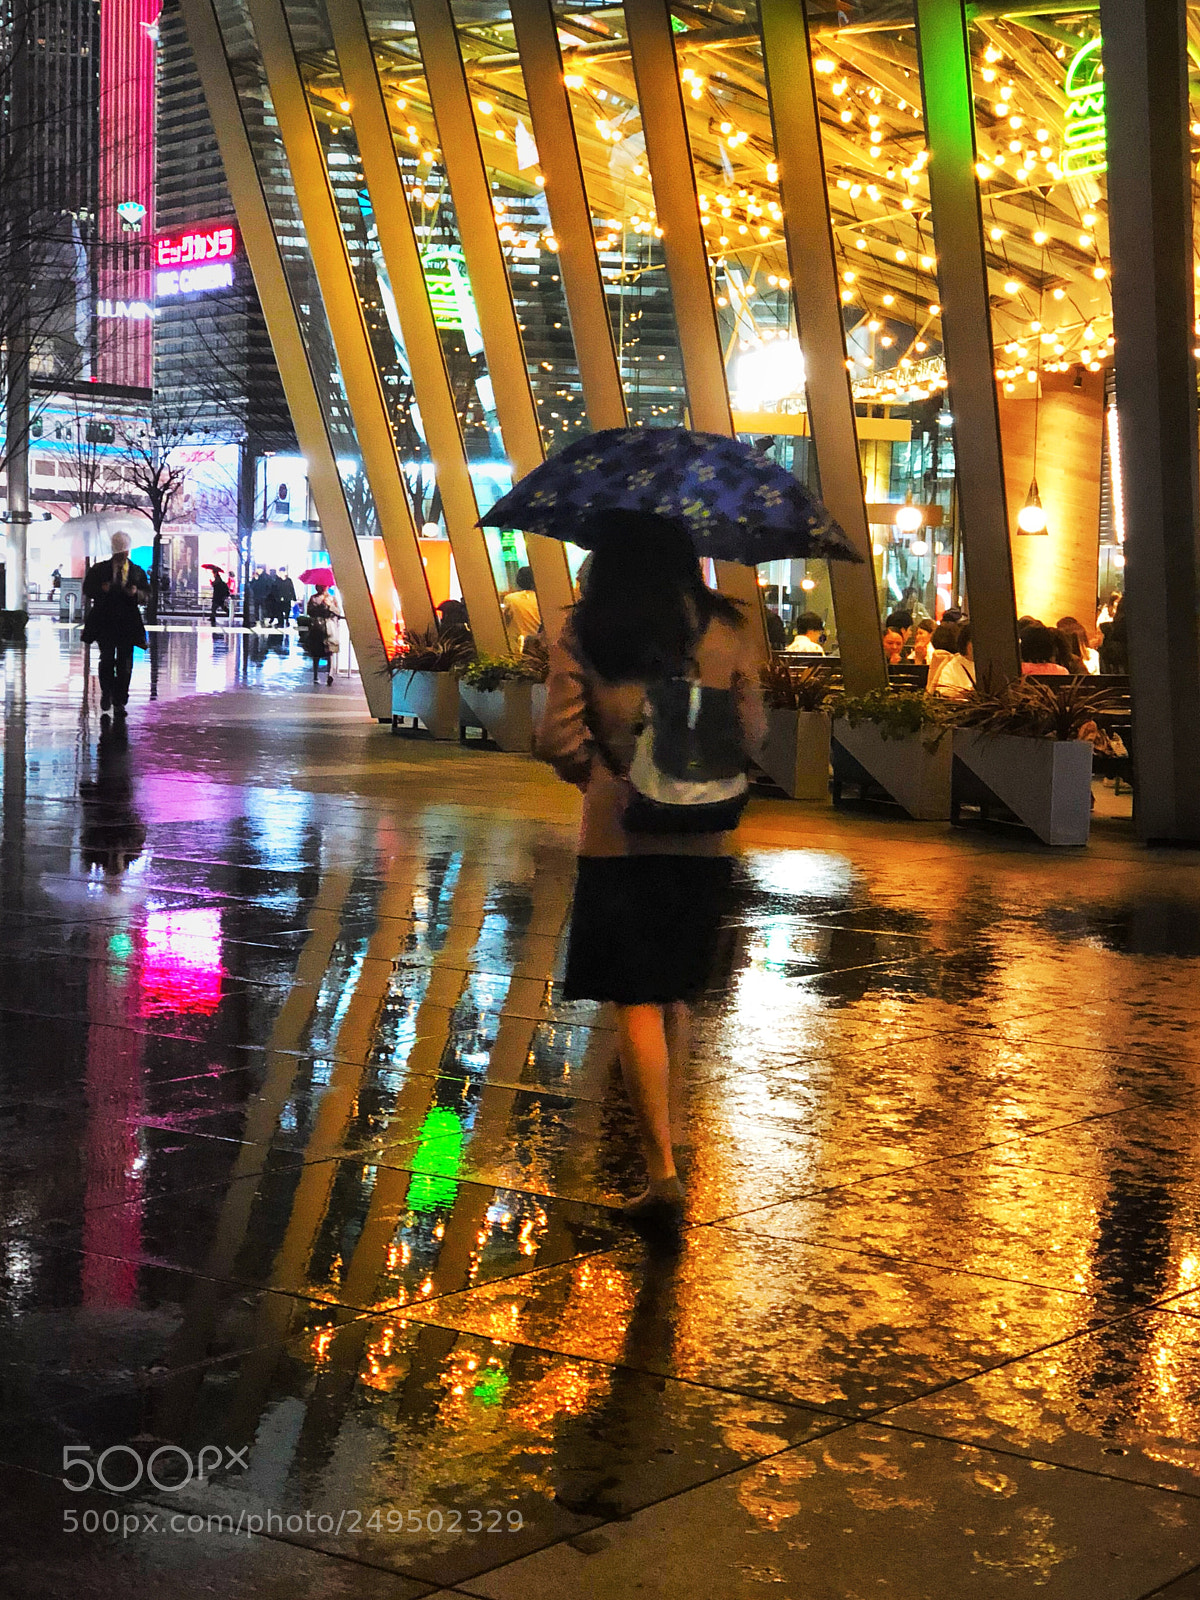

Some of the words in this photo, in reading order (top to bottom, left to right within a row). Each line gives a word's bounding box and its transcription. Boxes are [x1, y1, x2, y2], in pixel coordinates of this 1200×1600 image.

[157, 230, 233, 265] ビックカメラ
